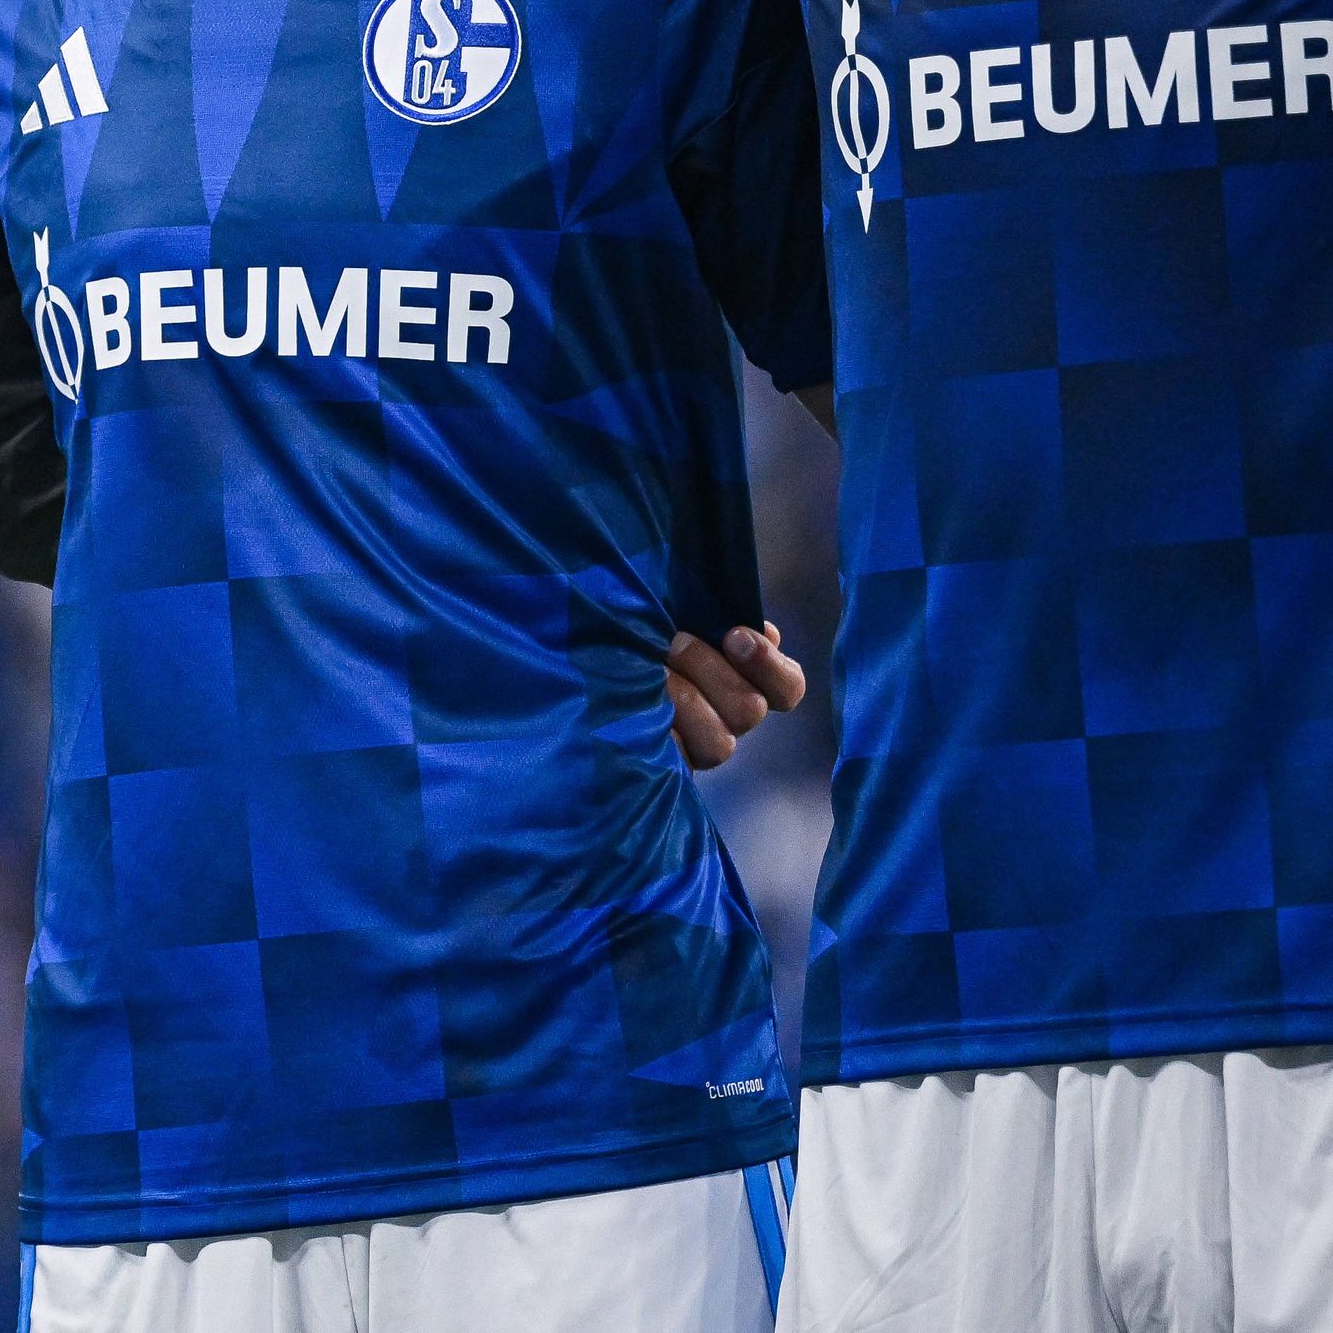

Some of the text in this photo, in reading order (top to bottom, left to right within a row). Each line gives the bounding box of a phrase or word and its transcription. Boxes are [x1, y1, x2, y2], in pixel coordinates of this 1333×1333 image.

[411, 59, 457, 106] 04
[907, 20, 1333, 150] BEUMER
[85, 265, 515, 371] BEUMER
